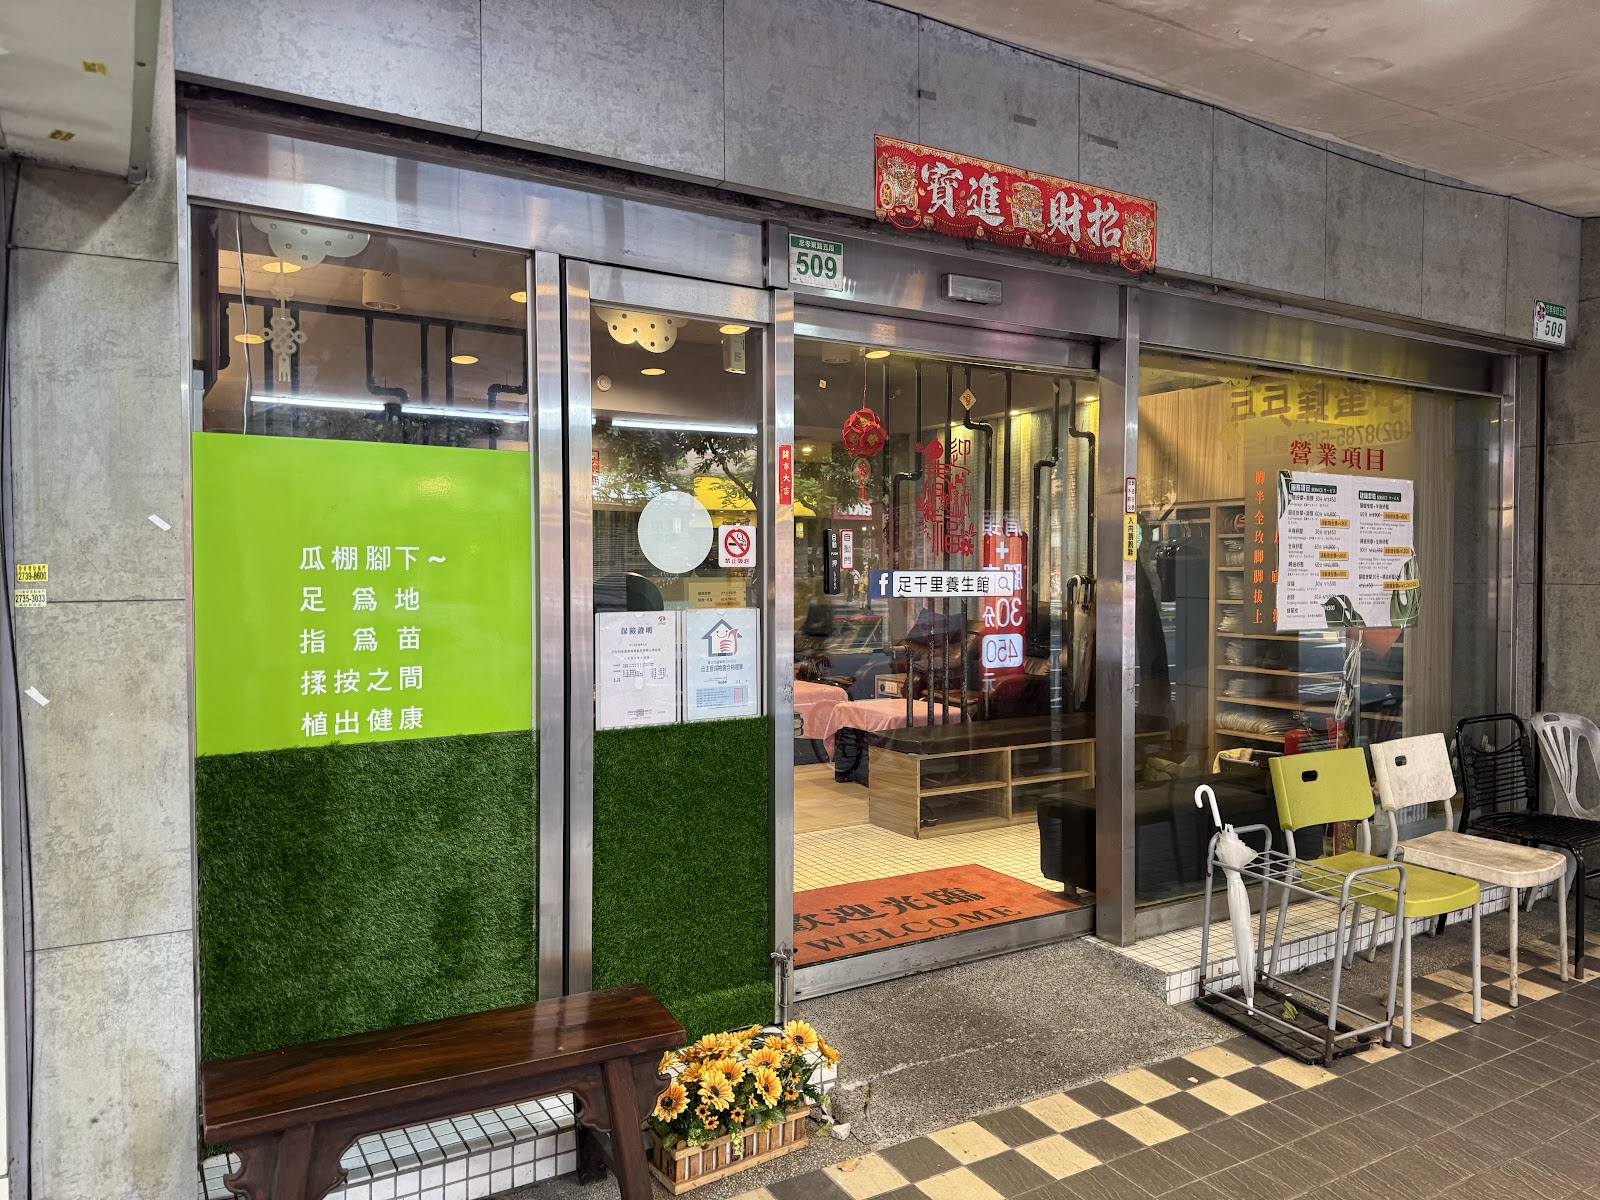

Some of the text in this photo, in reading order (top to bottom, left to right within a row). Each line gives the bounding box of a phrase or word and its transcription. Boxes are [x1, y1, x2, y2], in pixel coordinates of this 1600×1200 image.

[799, 239, 835, 252] 忠孝東路五段
[796, 252, 837, 279] 509
[1545, 320, 1563, 338] 509
[1290, 440, 1385, 471] 營業項目
[782, 449, 790, 496] 開市大吉
[843, 533, 851, 565] 自動門
[898, 576, 990, 594] 足千里養生館
[620, 626, 653, 635] 保險證明
[300, 666, 423, 695] 揉按之間
[301, 706, 424, 737] 植出健康
[804, 905, 1023, 952] WELCOME
